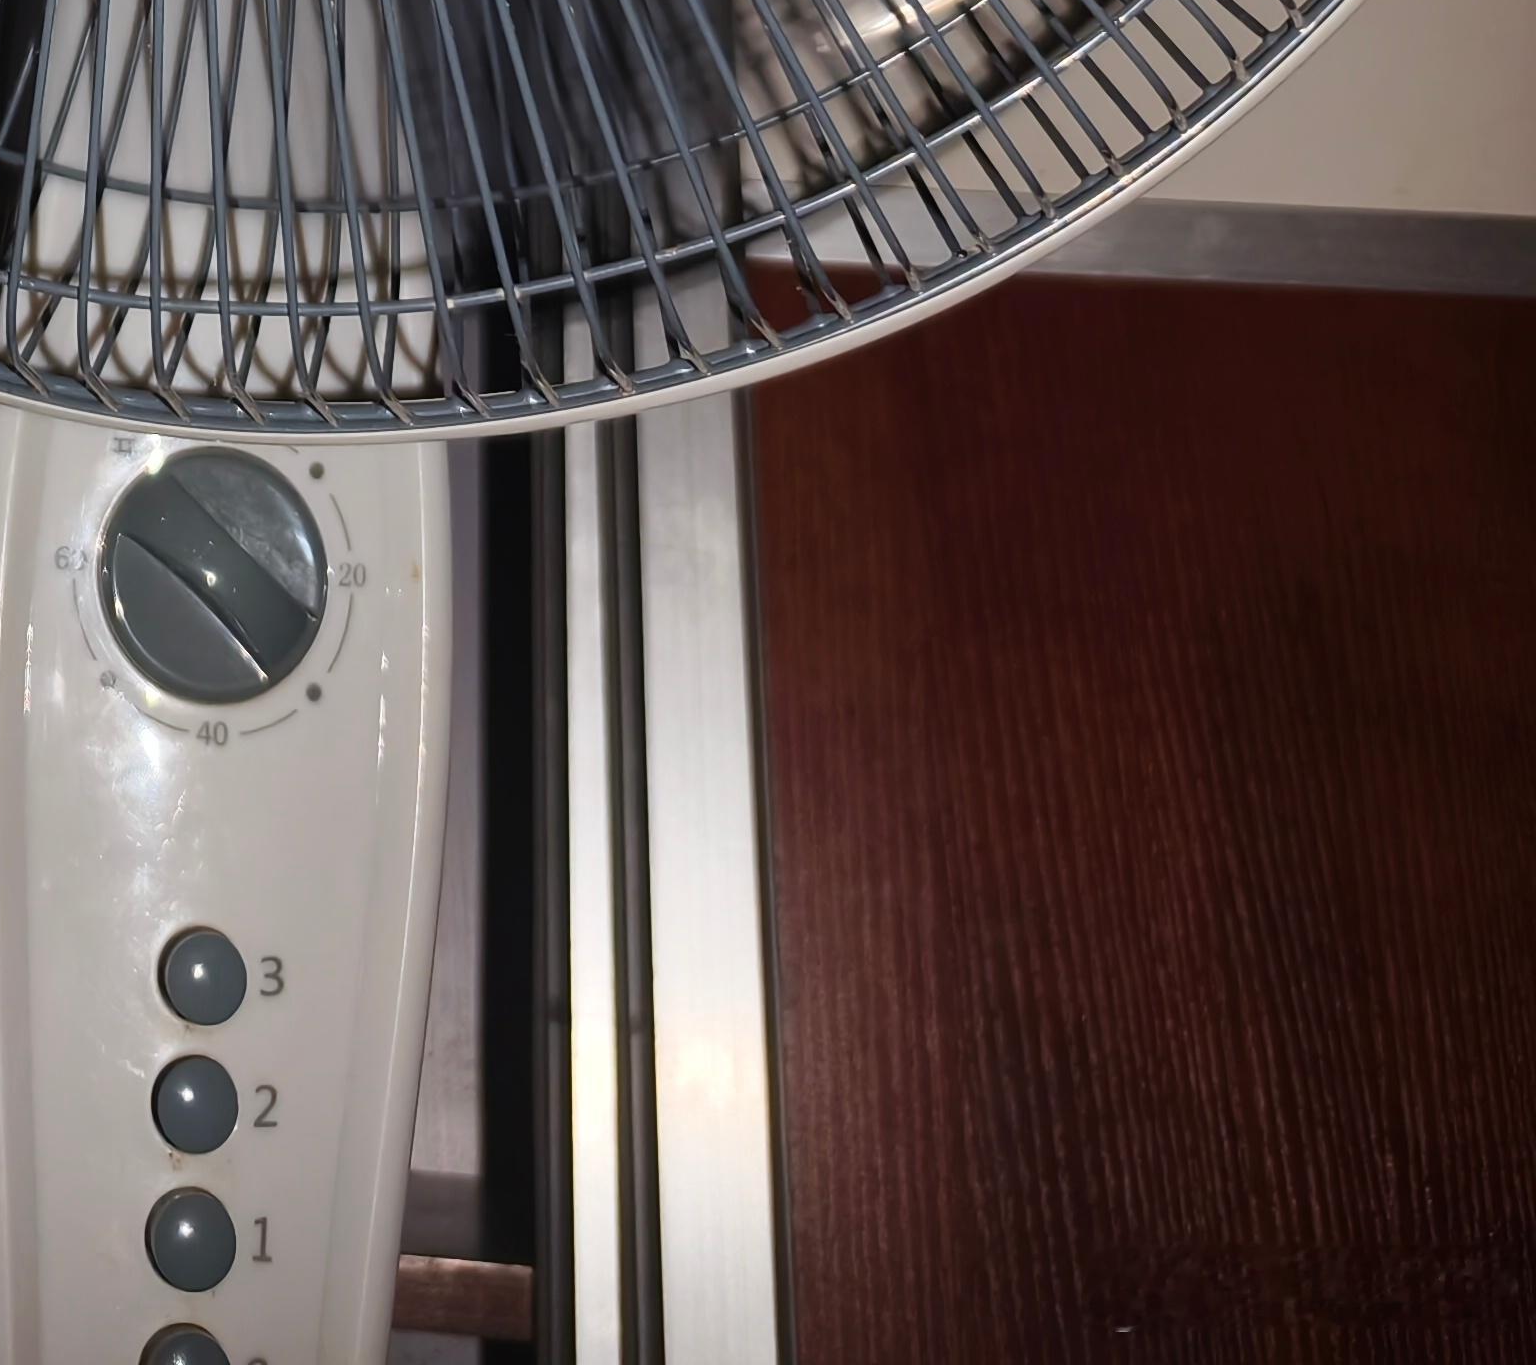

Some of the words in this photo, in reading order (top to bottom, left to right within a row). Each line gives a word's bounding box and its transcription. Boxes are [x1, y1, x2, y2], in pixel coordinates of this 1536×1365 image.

[339, 563, 366, 588] 20
[196, 721, 229, 746] 40
[259, 956, 285, 997] 3
[252, 1084, 278, 1128] 2
[251, 1216, 273, 1263] 1
